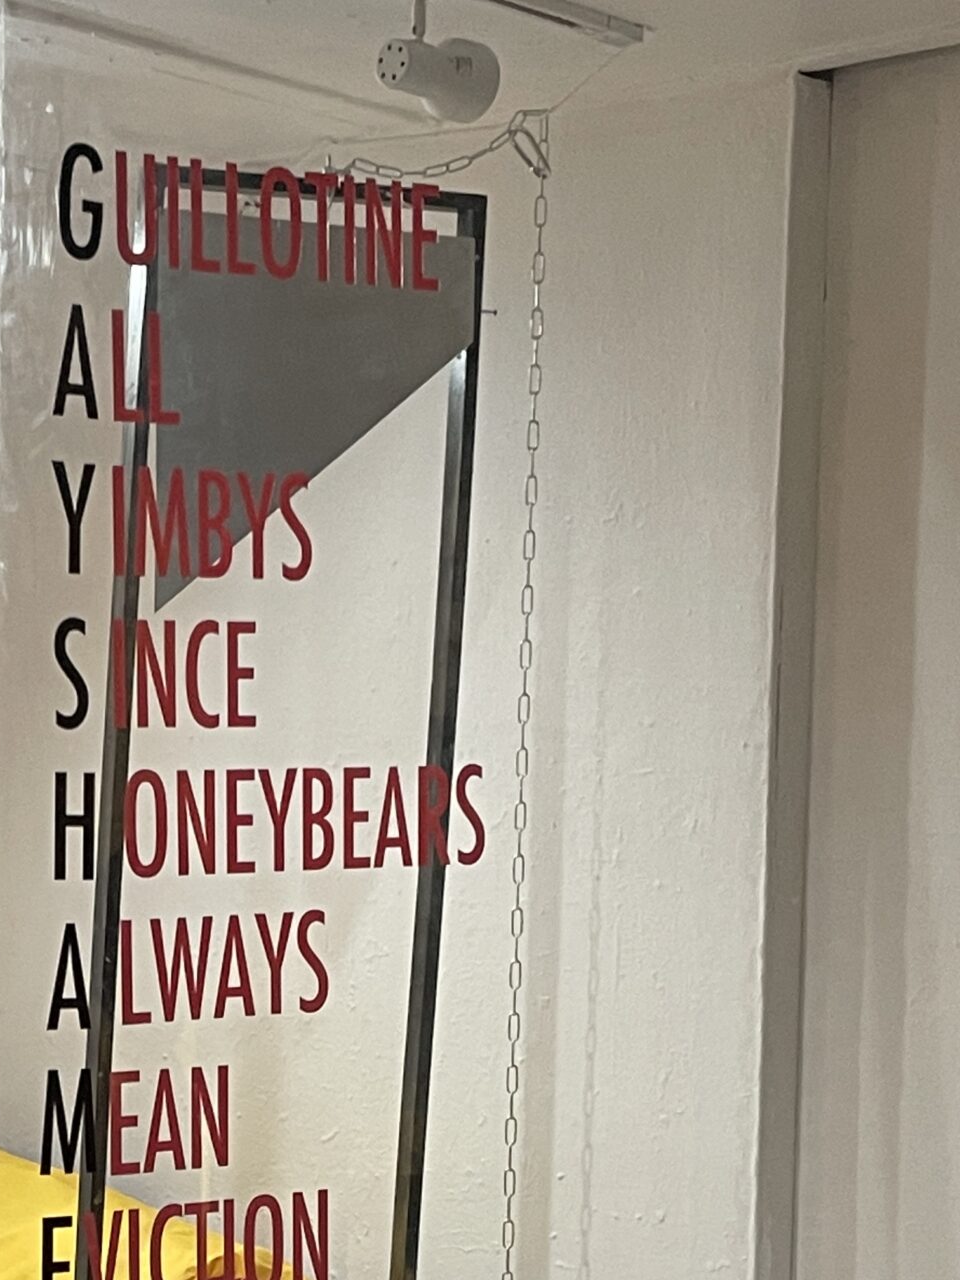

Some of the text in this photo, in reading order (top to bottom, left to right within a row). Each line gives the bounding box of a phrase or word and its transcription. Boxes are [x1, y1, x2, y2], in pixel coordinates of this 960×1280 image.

[58, 142, 439, 291] GUILLOTINE
[52, 304, 180, 425] ALL
[51, 460, 312, 581] YIMBYS
[54, 617, 257, 729] SINCE
[53, 764, 486, 880] HONEYBEARS
[47, 908, 329, 1030] ALWAYS
[40, 1065, 229, 1175] MEAN
